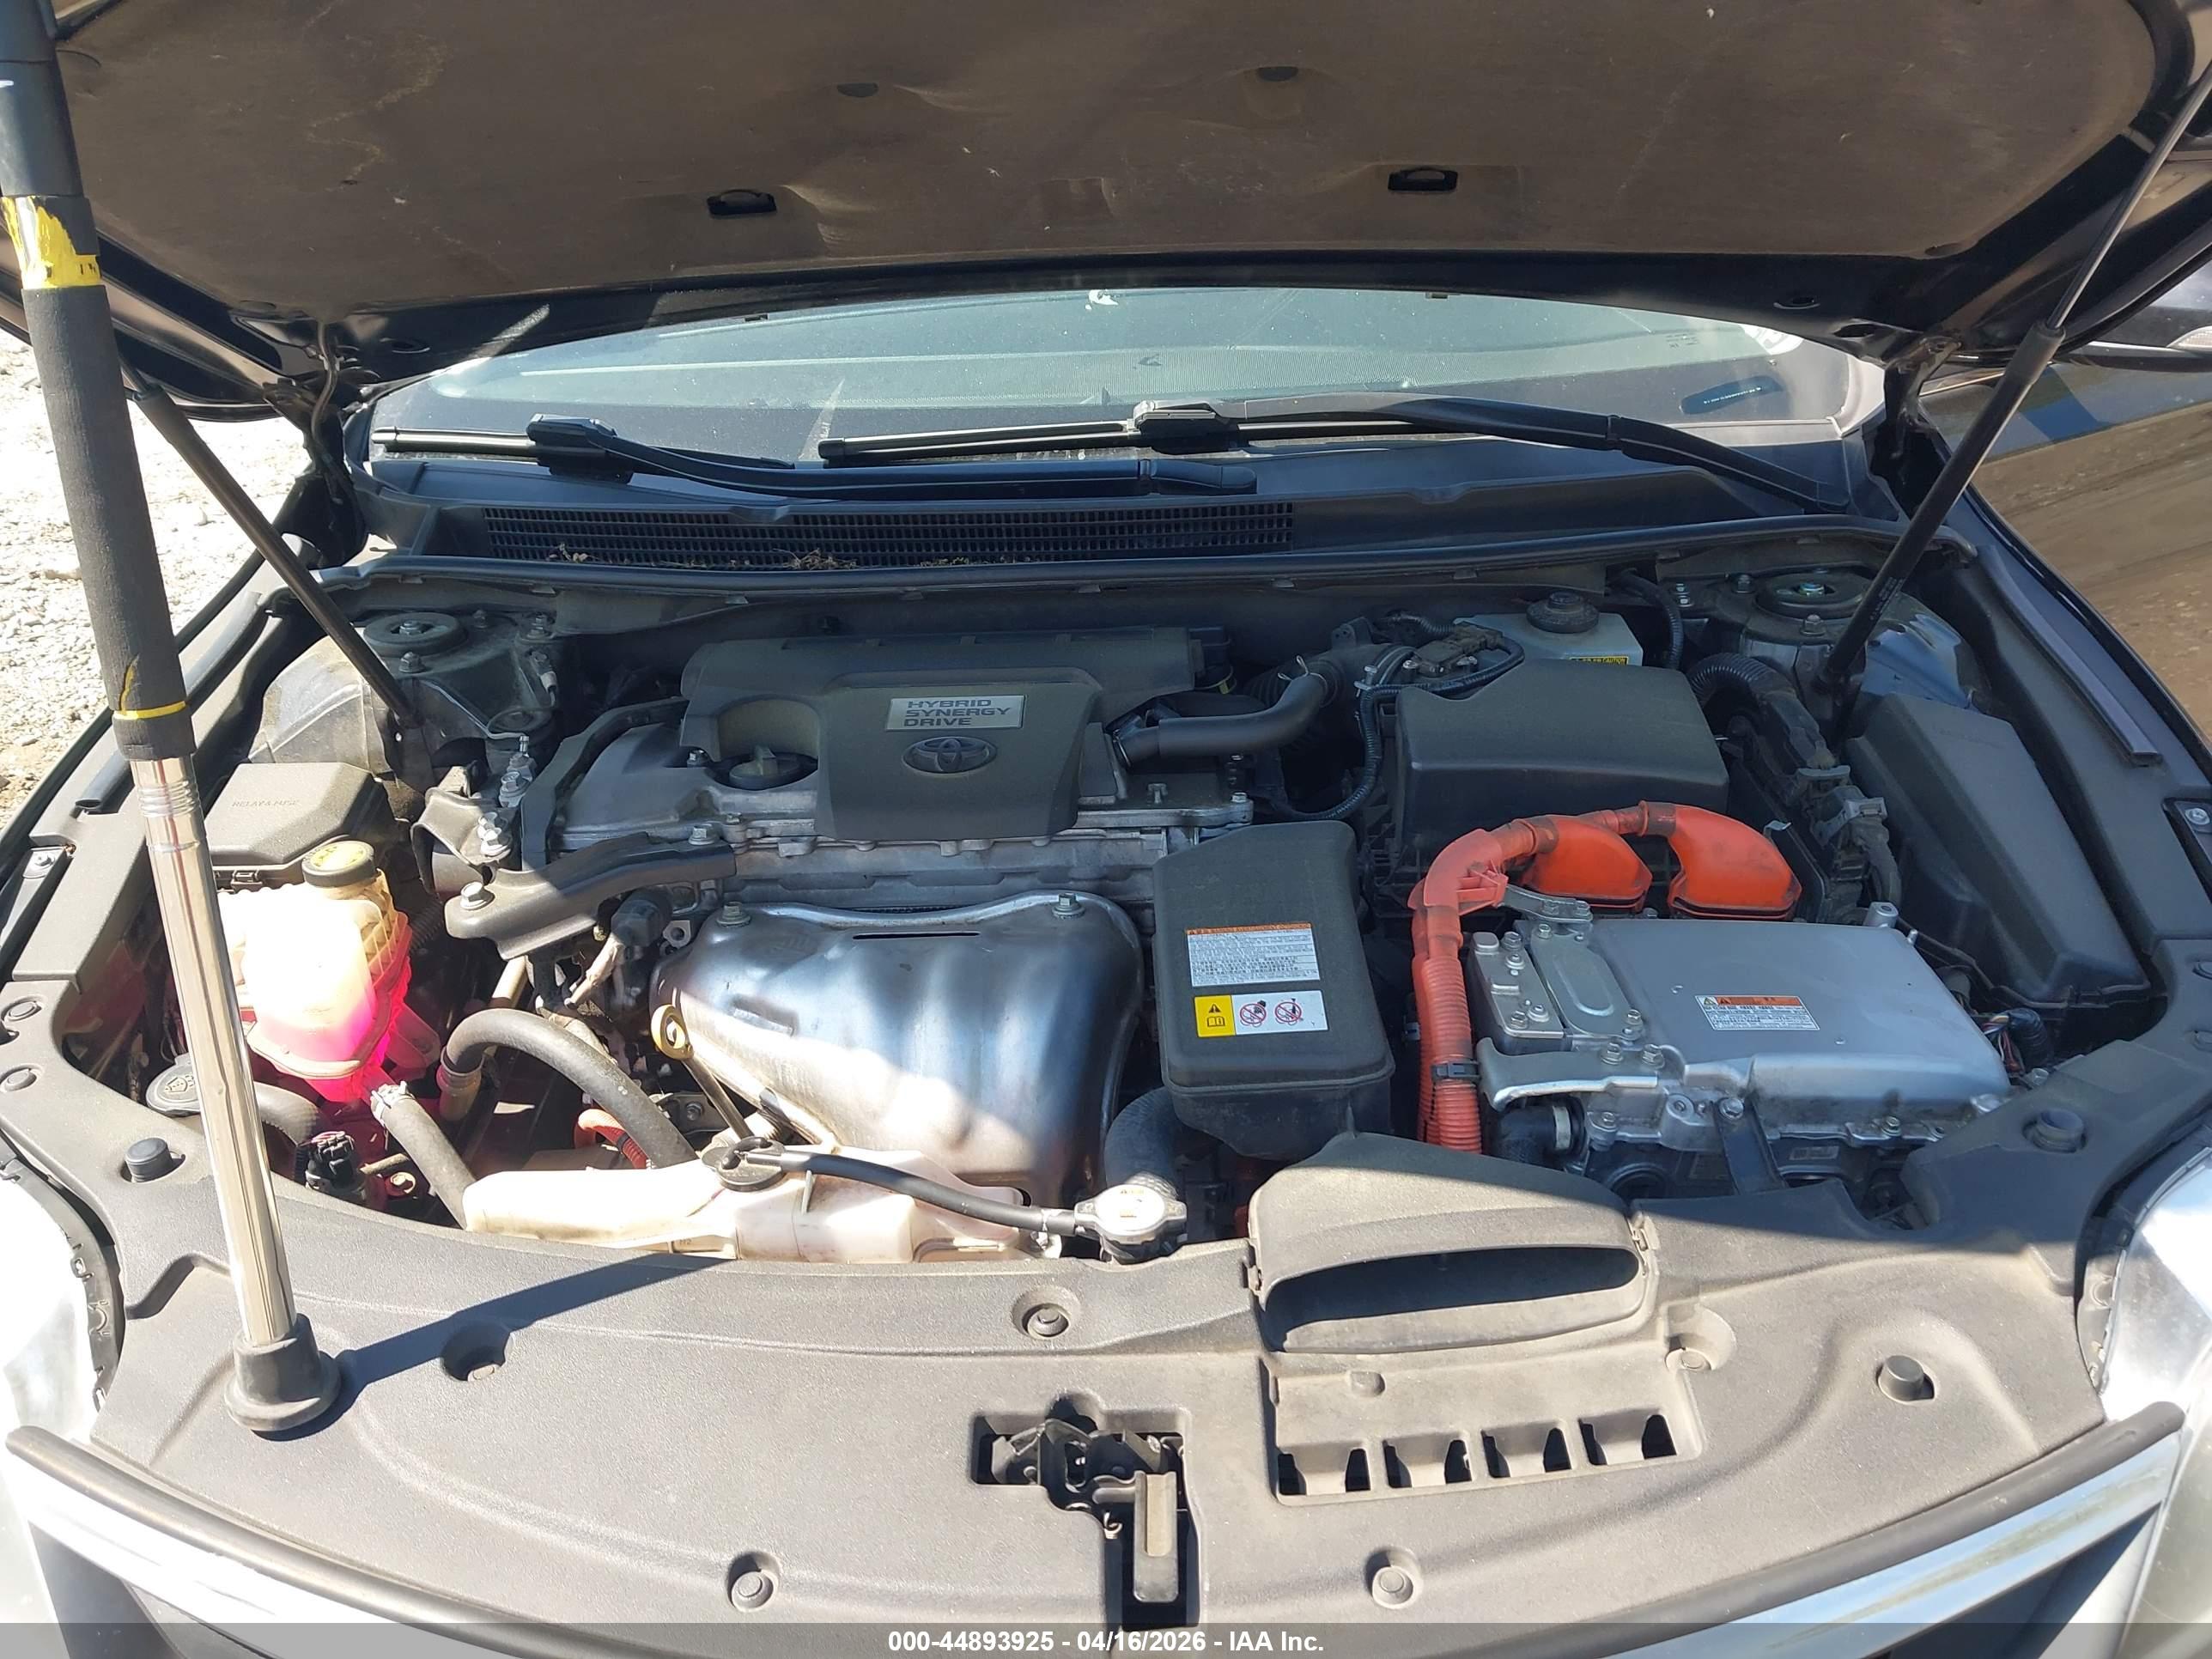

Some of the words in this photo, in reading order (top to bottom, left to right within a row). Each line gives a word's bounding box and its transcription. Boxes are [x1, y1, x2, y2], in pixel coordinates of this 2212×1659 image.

[908, 700, 992, 708] HYBRID
[905, 708, 1011, 717] SYNERGY
[903, 718, 972, 726] DRIVE
